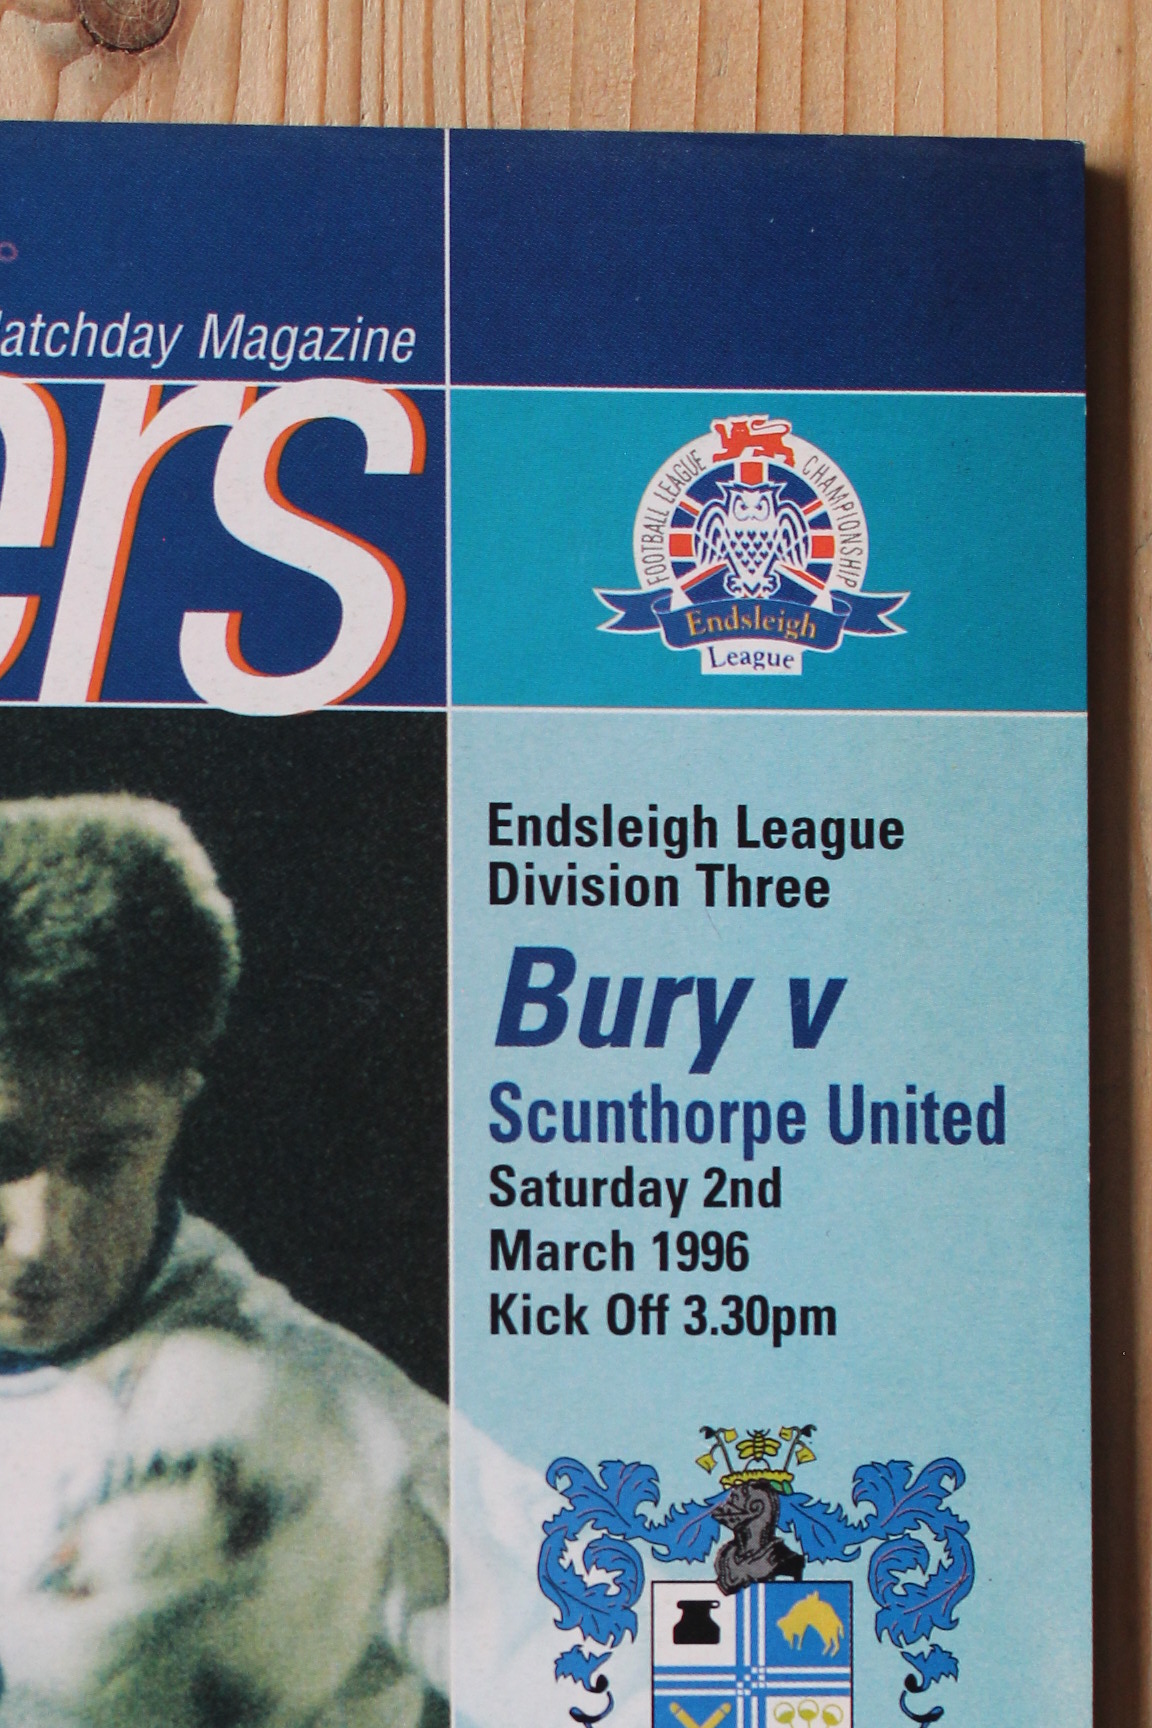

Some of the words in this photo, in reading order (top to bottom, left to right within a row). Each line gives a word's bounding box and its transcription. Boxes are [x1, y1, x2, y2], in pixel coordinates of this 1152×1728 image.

[198, 313, 416, 370] Magazine
[653, 449, 707, 504] LEAGUE
[640, 506, 671, 587] FOOTBALL
[802, 454, 864, 589] CHAMPIONSHIP
[686, 604, 816, 640] Endsleigh
[707, 646, 796, 671] League
[488, 802, 718, 859] Endsleigh
[737, 805, 905, 860] League
[488, 861, 679, 907] Division
[696, 863, 831, 908] Three
[494, 945, 756, 1075] Bury
[788, 977, 848, 1049] v
[489, 1081, 807, 1161] Scunthorpe
[828, 1084, 1006, 1146] United
[489, 1164, 689, 1218] Saturday
[703, 1166, 782, 1208] 2nd
[489, 1228, 635, 1272] March
[651, 1231, 749, 1272] 1996
[489, 1292, 589, 1335] Kick
[606, 1293, 670, 1336] Off
[682, 1294, 838, 1347] 3.30pm
